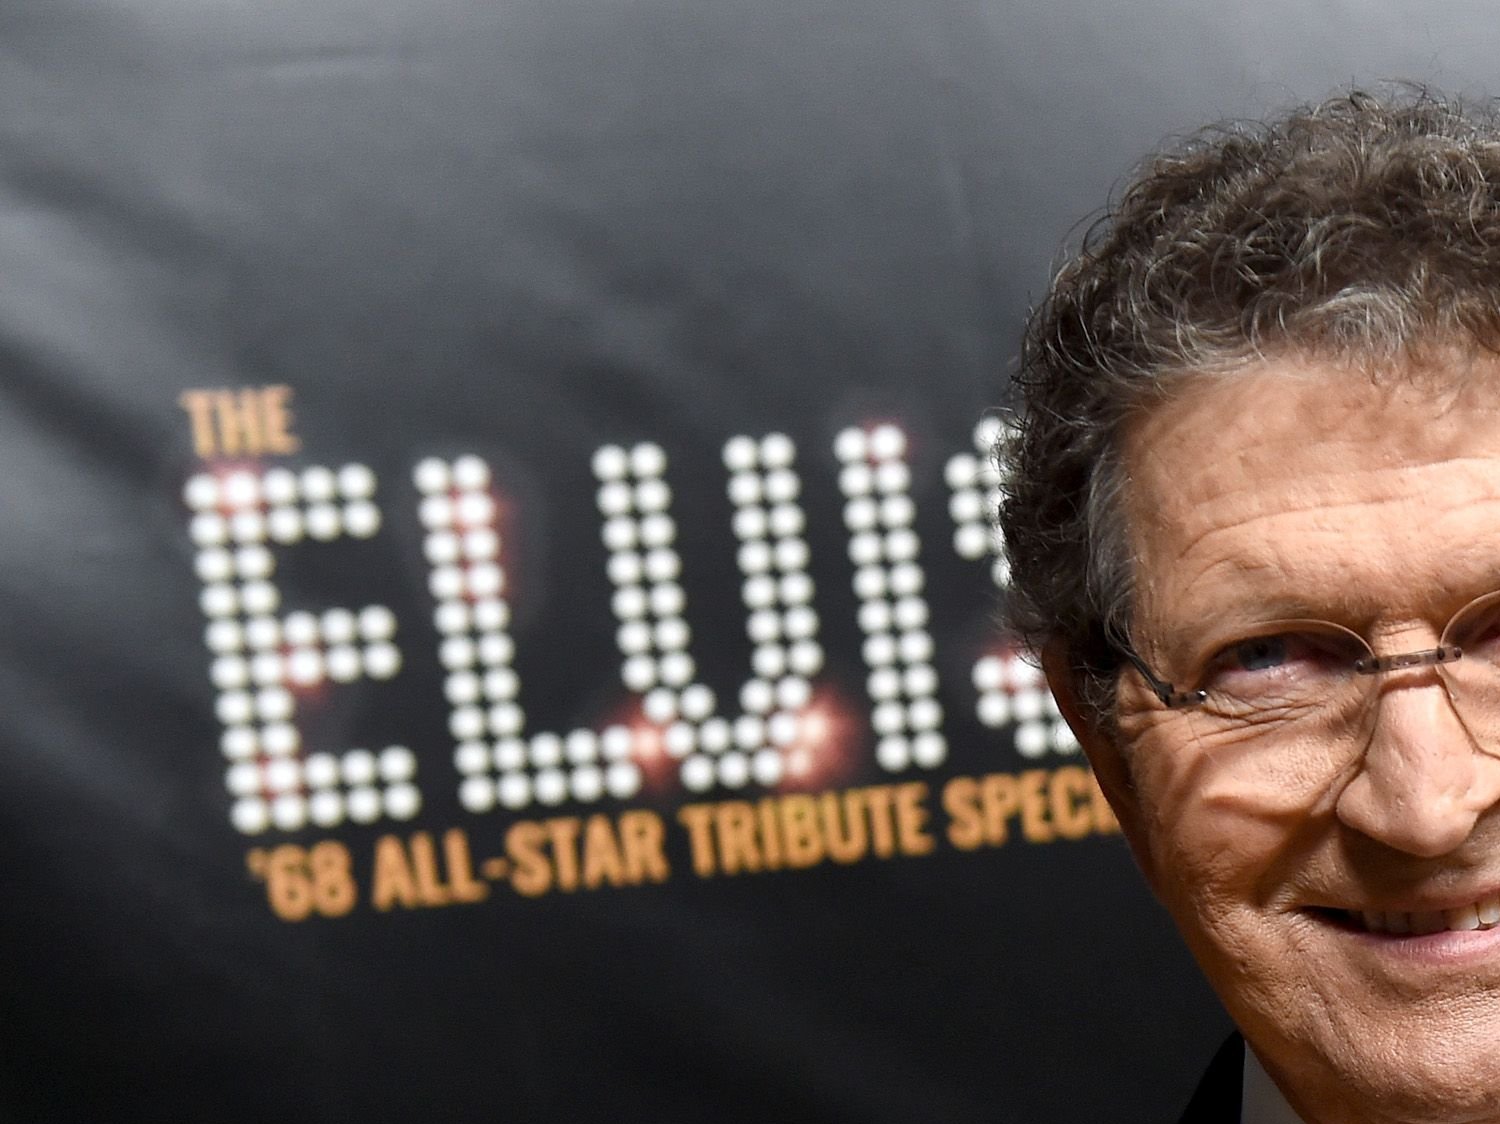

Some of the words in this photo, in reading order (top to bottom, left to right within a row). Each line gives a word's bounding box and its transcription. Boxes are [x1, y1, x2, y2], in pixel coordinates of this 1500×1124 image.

[180, 385, 299, 457] THE
[246, 839, 357, 922] '68
[371, 808, 670, 912] ALL-STAR
[677, 782, 936, 877] TRIBUTE
